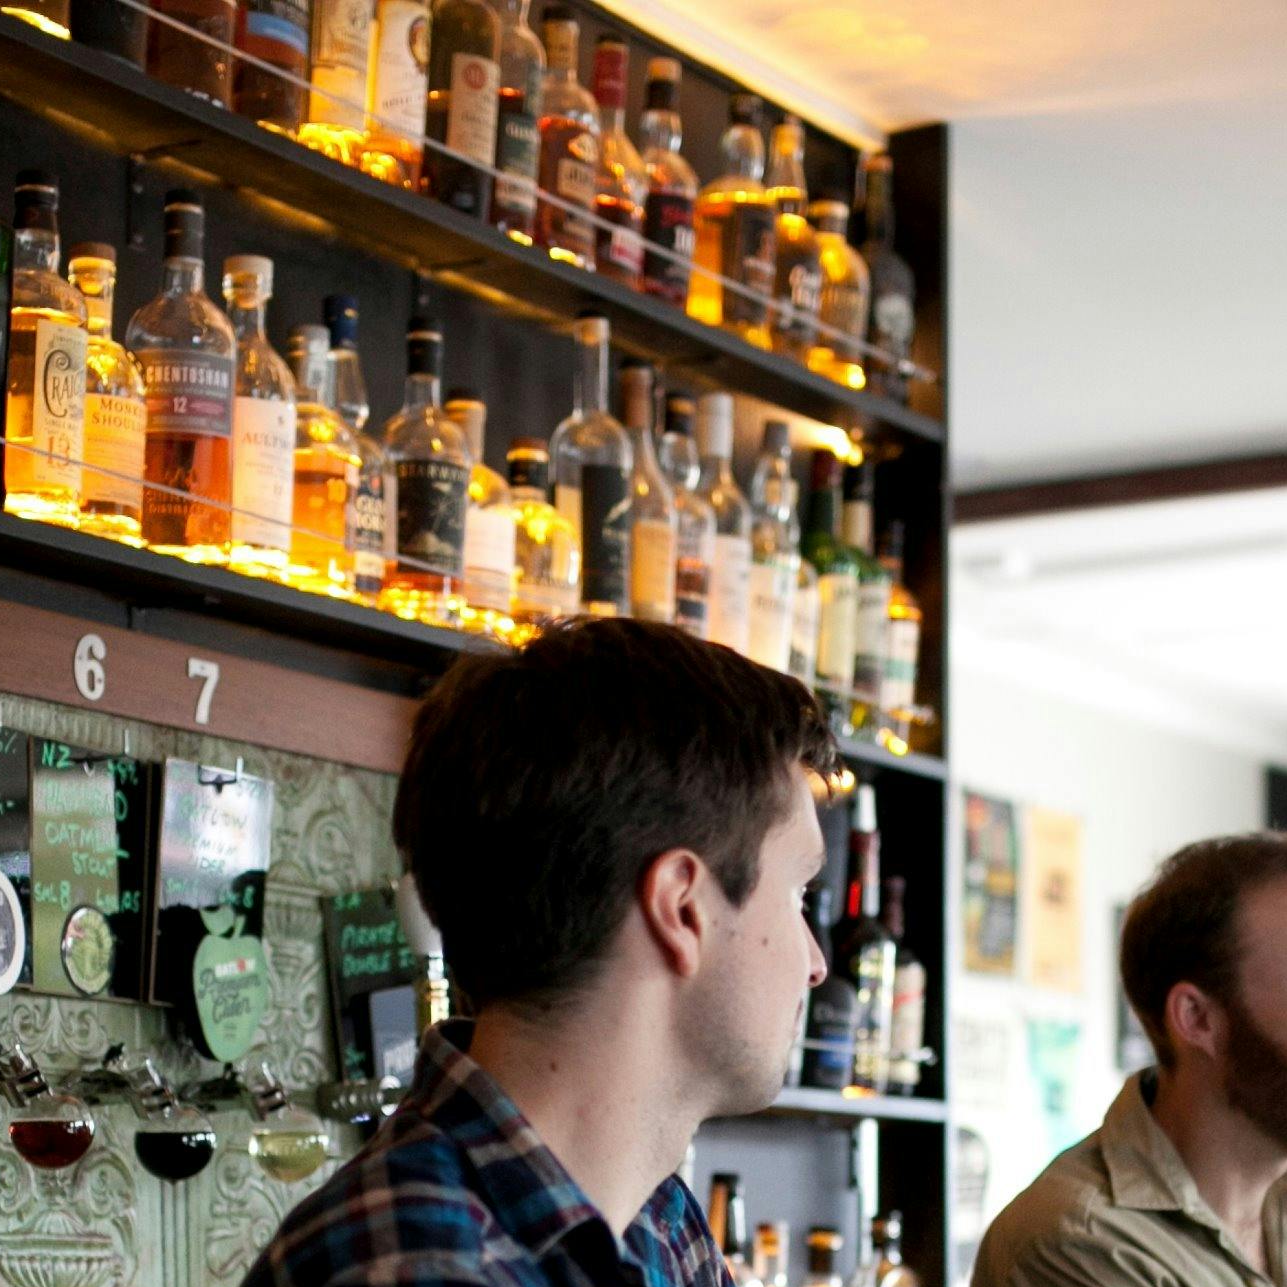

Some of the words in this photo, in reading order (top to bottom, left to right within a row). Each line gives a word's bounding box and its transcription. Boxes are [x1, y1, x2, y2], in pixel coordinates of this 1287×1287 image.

[173, 396, 188, 413] 12
[74, 634, 106, 700] 6
[187, 657, 219, 724] 7
[41, 741, 74, 769] NZ
